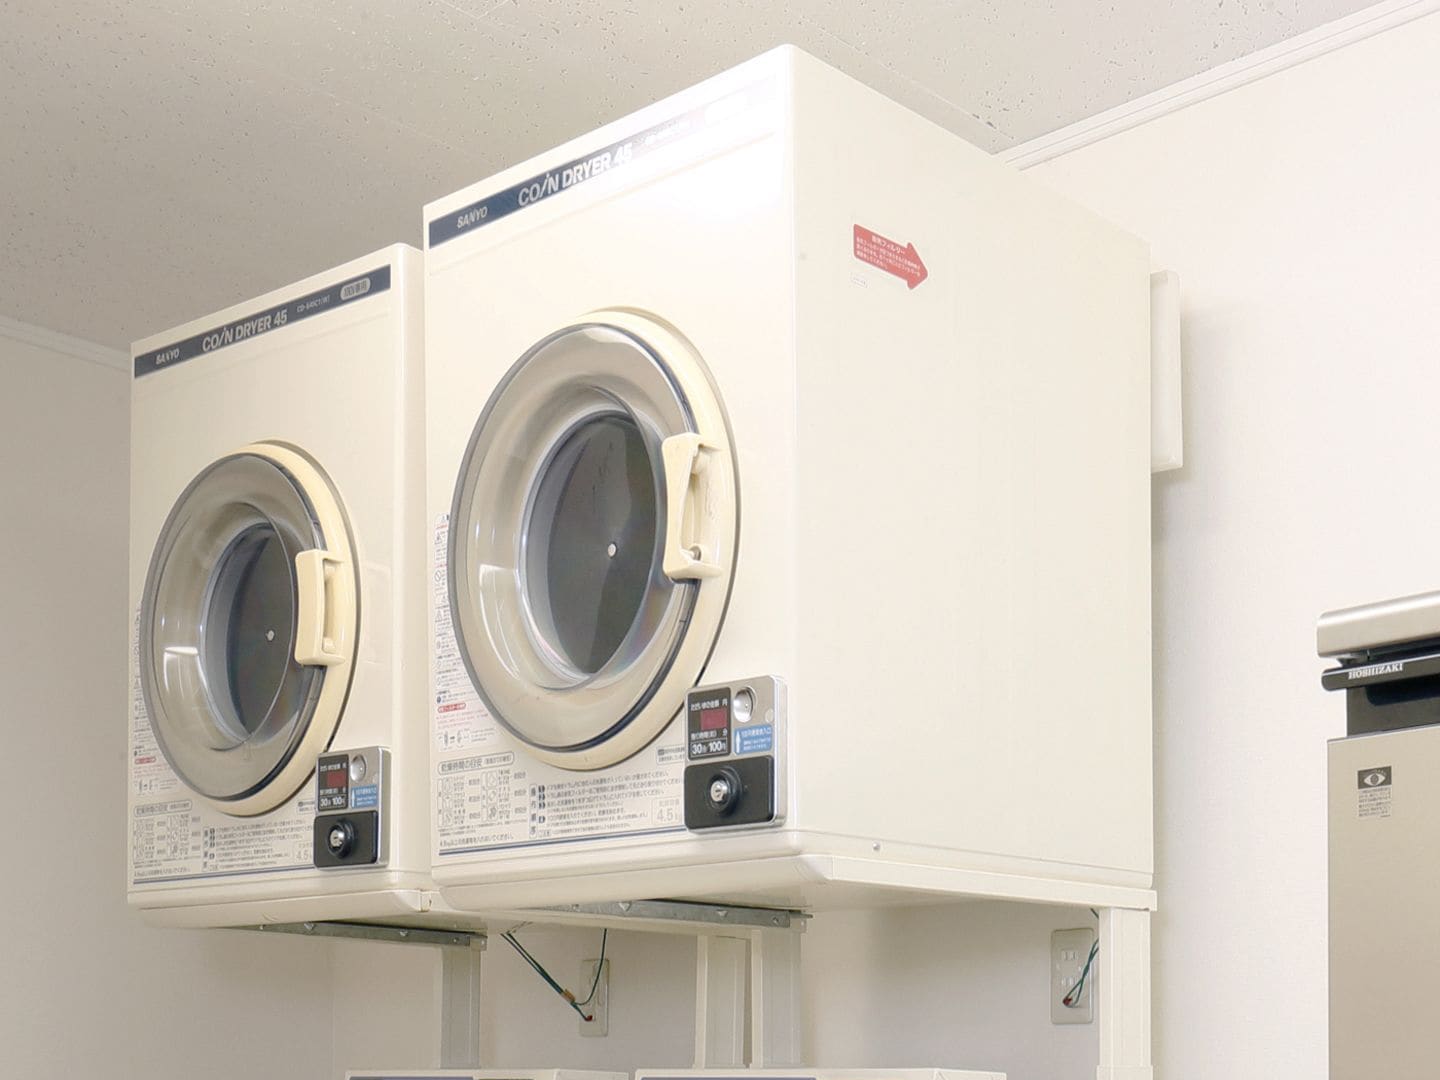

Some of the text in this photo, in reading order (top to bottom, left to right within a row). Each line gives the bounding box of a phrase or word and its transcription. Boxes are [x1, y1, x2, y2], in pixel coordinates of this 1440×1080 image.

[457, 206, 488, 229] SANYO
[518, 172, 559, 207] COIN
[562, 151, 613, 189] DRYER
[156, 348, 180, 365] SANYO
[202, 326, 233, 352] COIN
[236, 313, 272, 341] DRYER
[274, 309, 288, 326] 45
[1348, 663, 1403, 680] HOSHIZAKI
